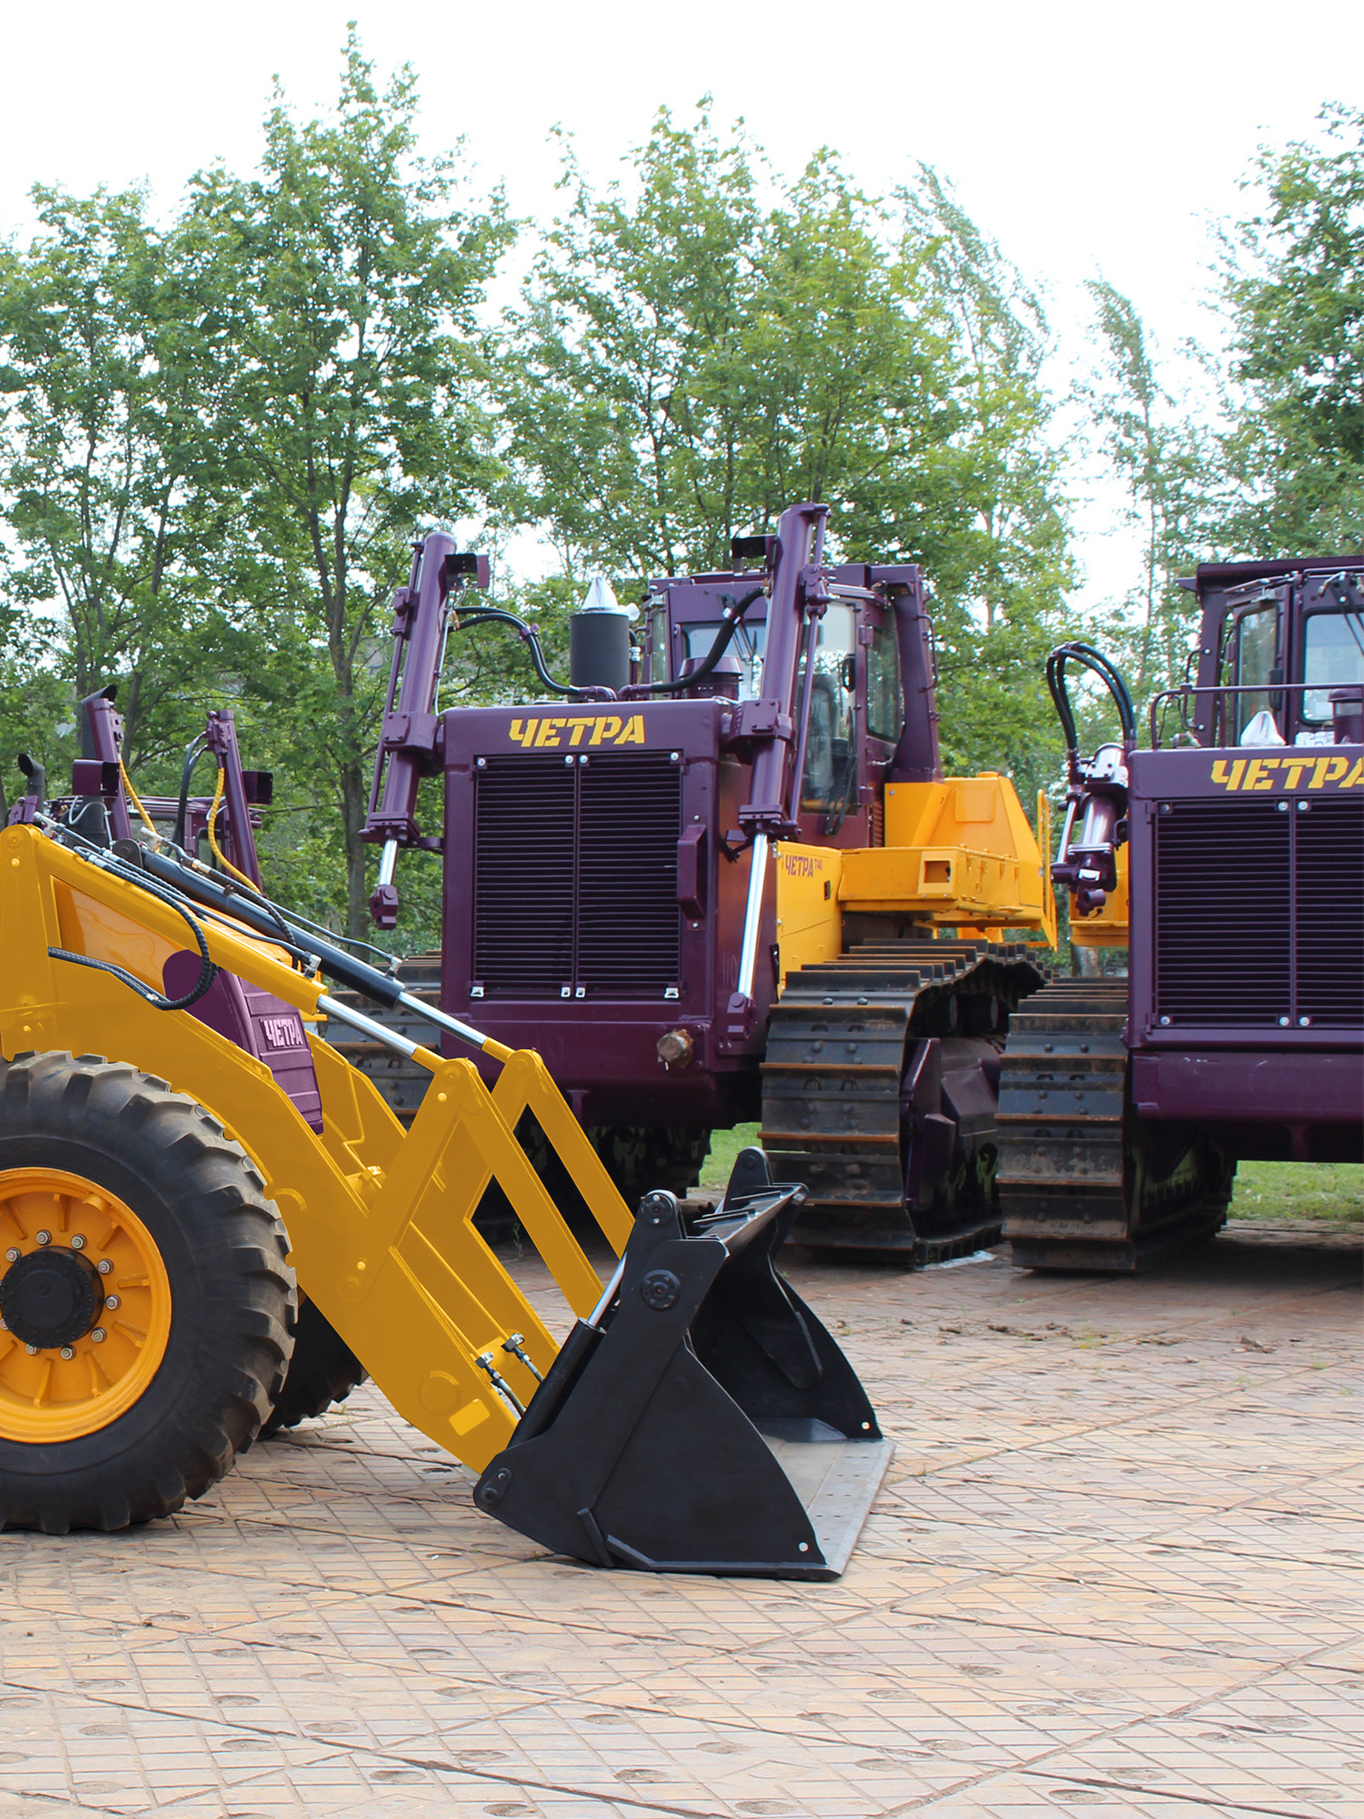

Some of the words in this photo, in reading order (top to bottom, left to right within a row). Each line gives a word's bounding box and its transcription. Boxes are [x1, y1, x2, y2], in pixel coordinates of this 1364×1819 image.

[509, 715, 646, 748] ЧЕТРА
[785, 855, 813, 878] ЧЕТРА
[263, 1016, 304, 1047] ЧЕТРА
